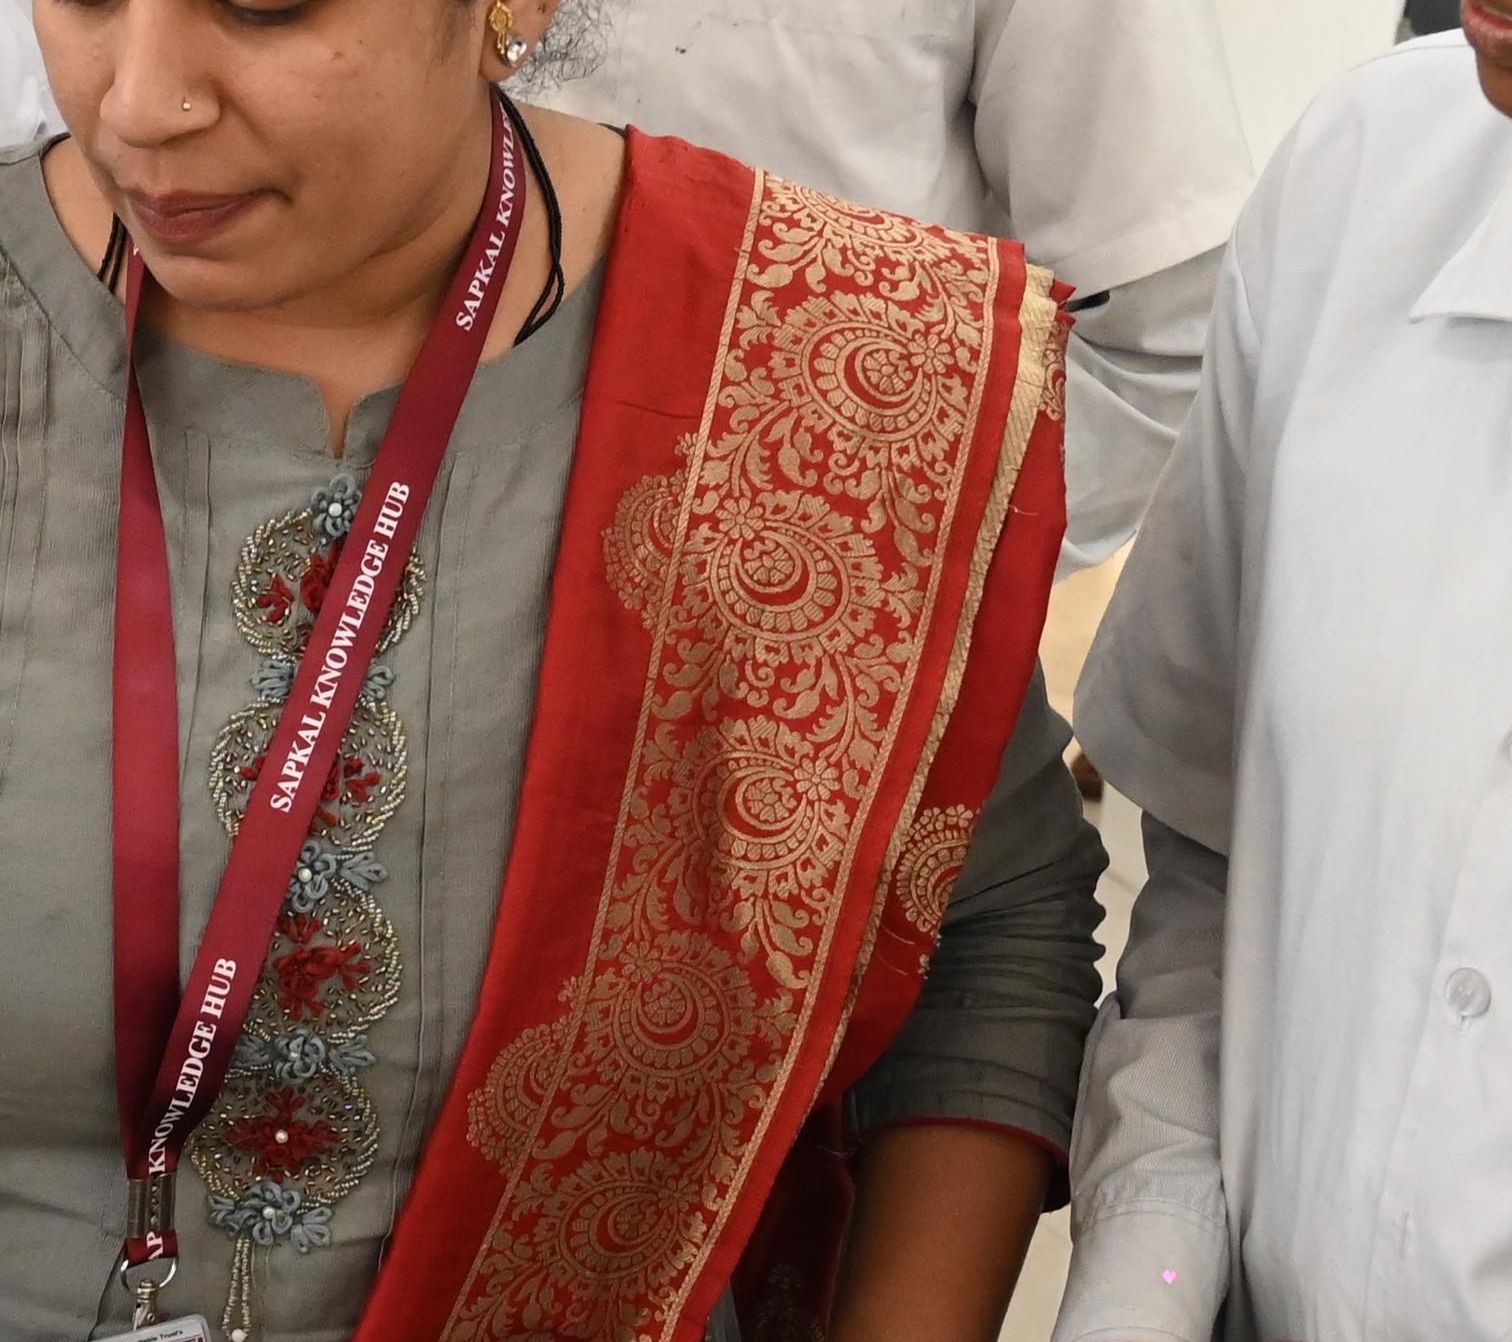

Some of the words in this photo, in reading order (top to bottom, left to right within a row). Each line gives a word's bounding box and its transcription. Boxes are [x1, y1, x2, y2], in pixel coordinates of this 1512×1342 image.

[455, 230, 506, 332] SAPKAL
[269, 711, 326, 813] SAPKAL
[309, 539, 390, 709] KNOWLEDGE
[374, 481, 411, 540] HUB
[147, 1020, 218, 1176] KNOWLEDGE
[200, 957, 238, 1020] HUB
